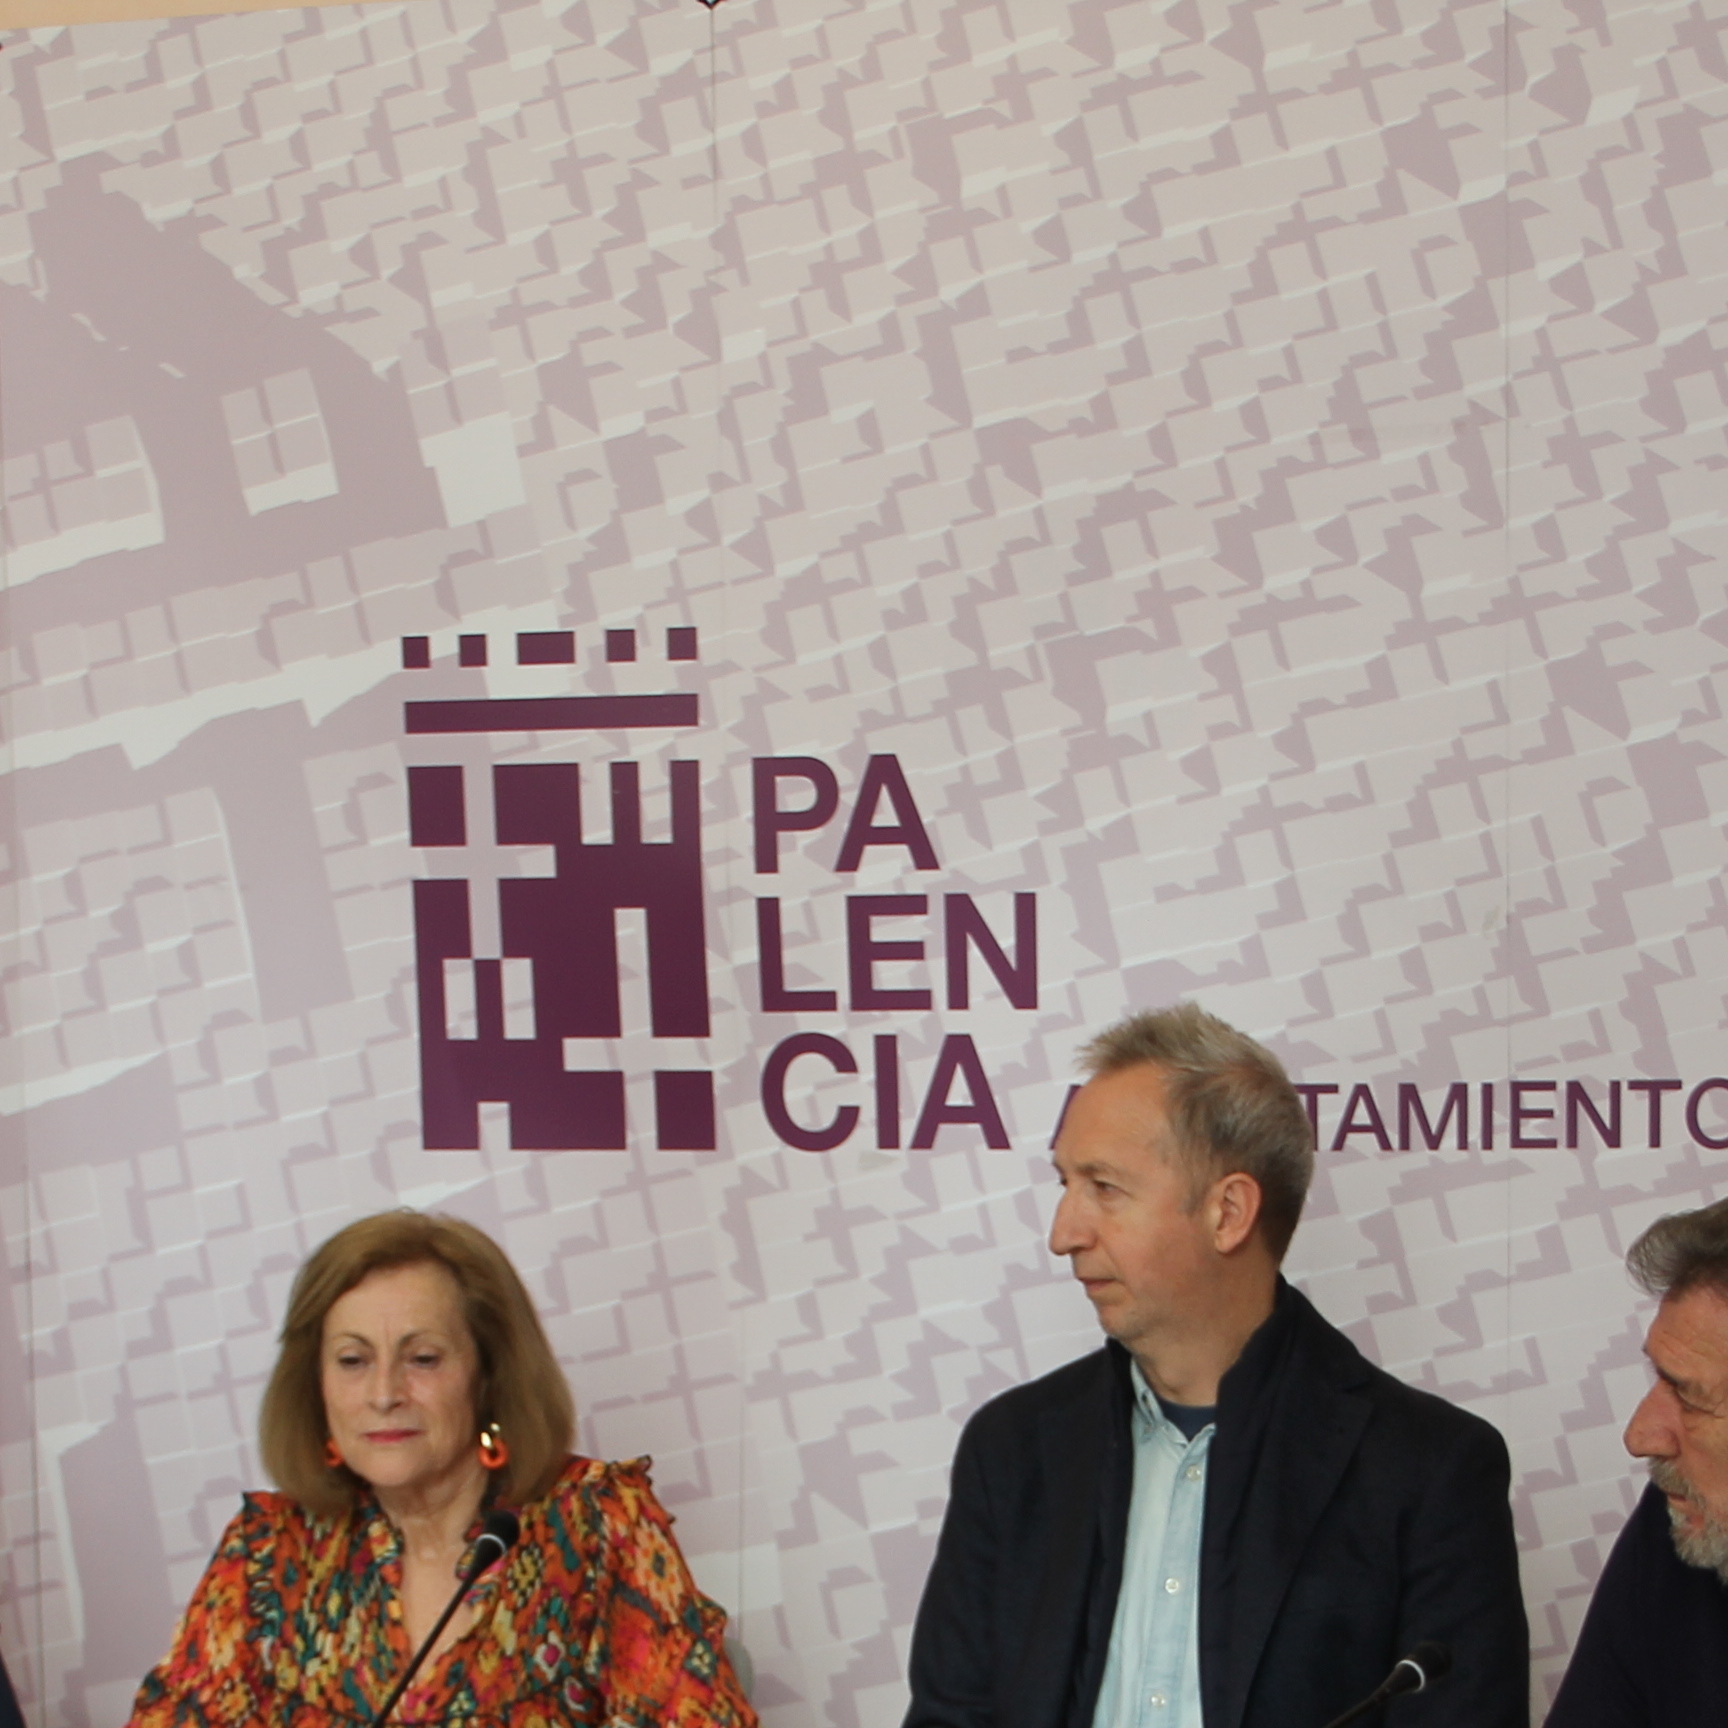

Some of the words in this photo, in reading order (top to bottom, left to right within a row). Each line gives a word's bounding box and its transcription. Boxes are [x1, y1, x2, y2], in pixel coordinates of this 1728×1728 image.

[753, 753, 940, 875] PA
[758, 892, 1038, 1013] LEN
[761, 1032, 1011, 1152] CIA
